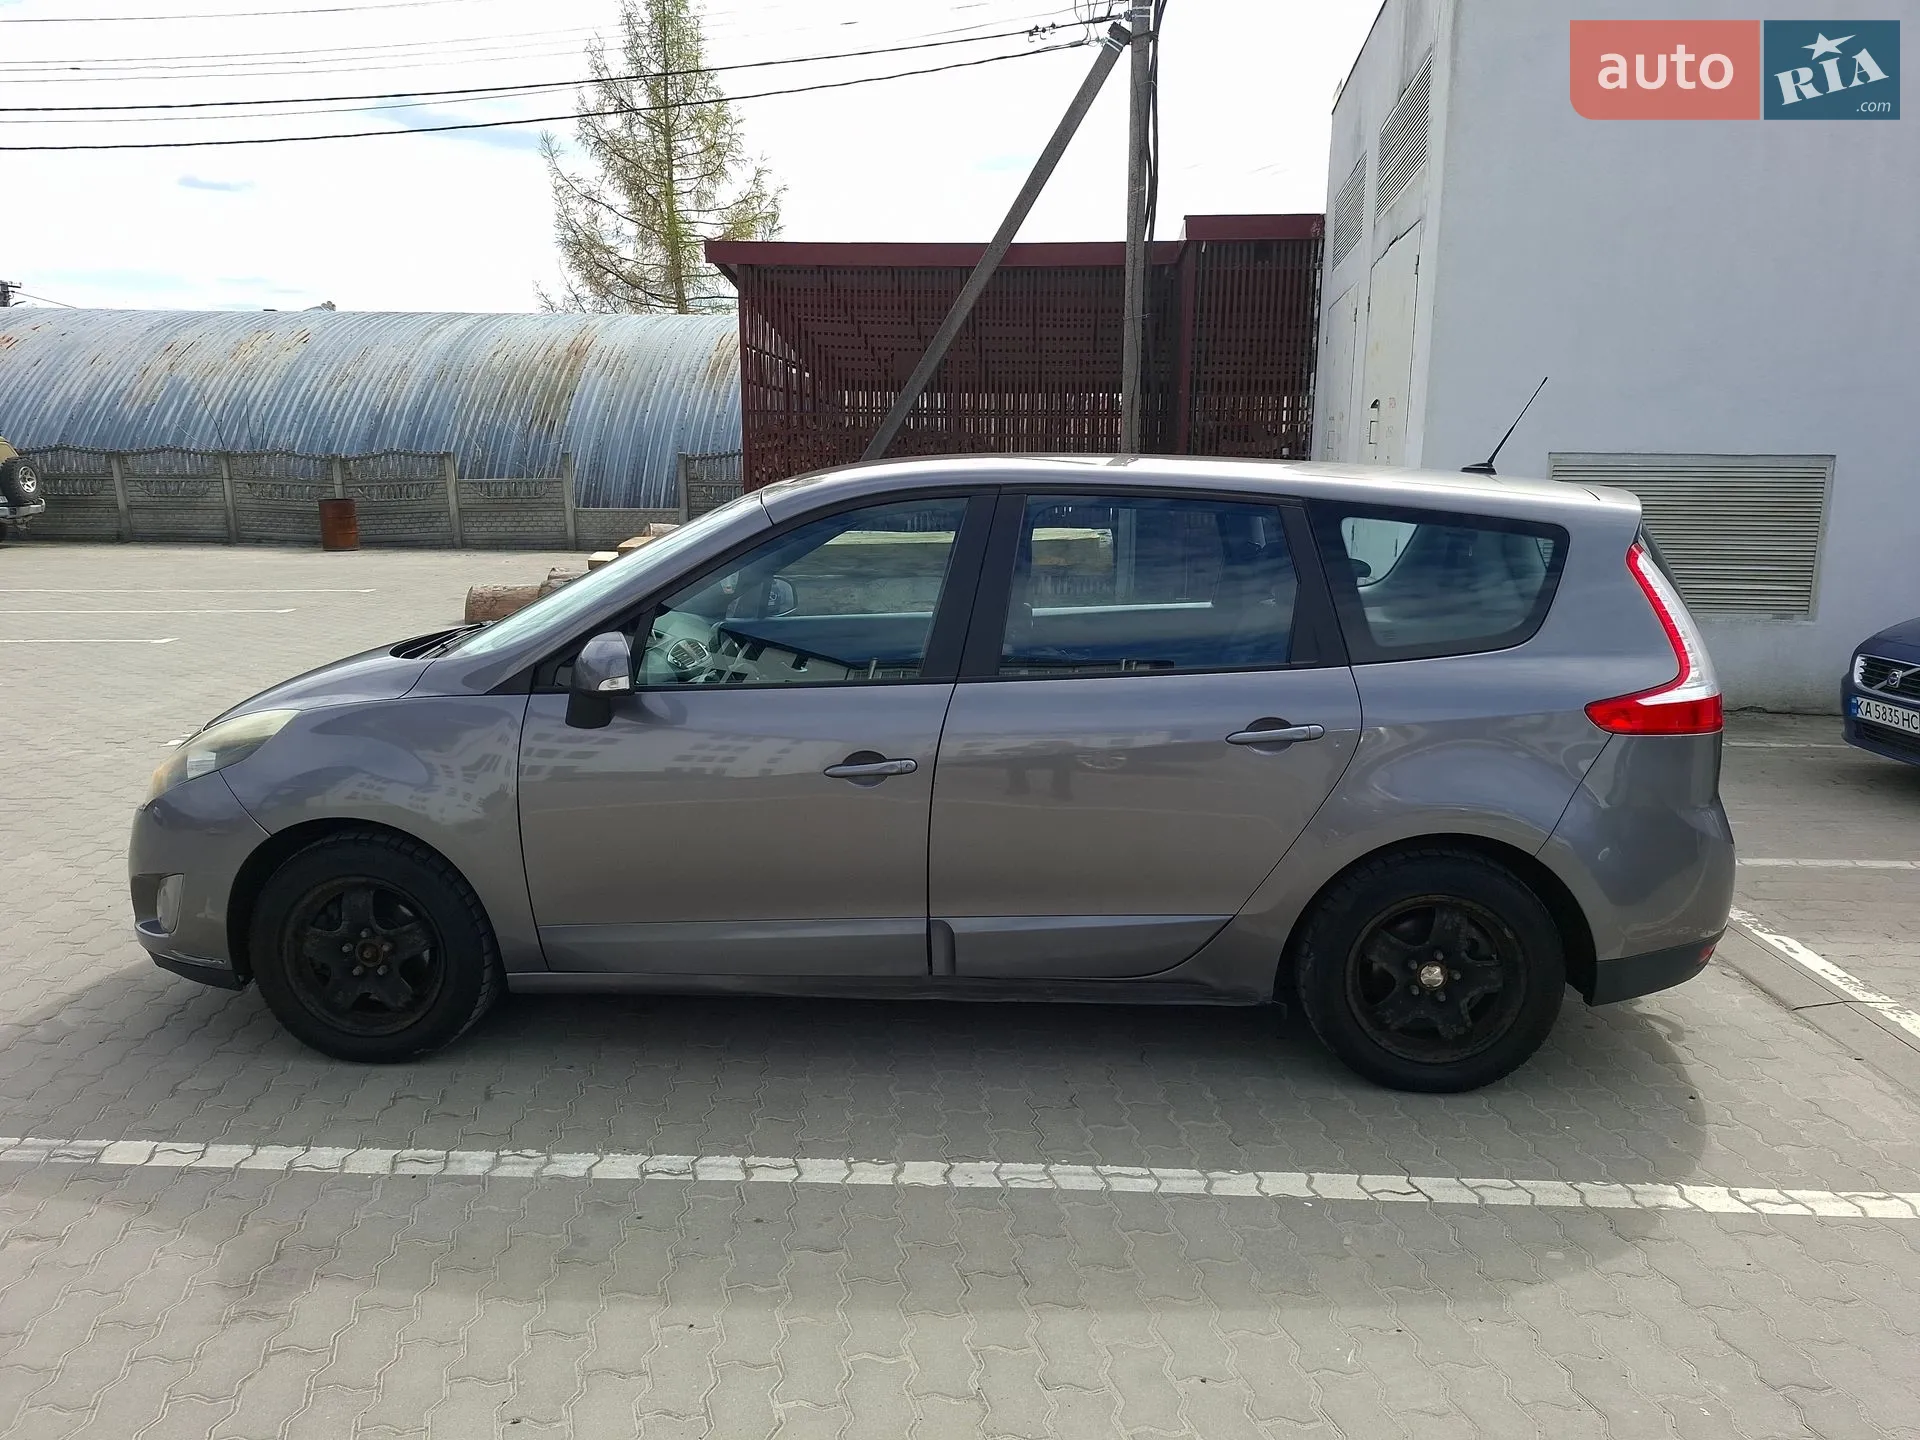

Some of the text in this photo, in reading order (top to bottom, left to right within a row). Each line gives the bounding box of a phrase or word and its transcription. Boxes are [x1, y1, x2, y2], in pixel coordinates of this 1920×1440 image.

[1857, 700, 1919, 730] KA 5835 HC
